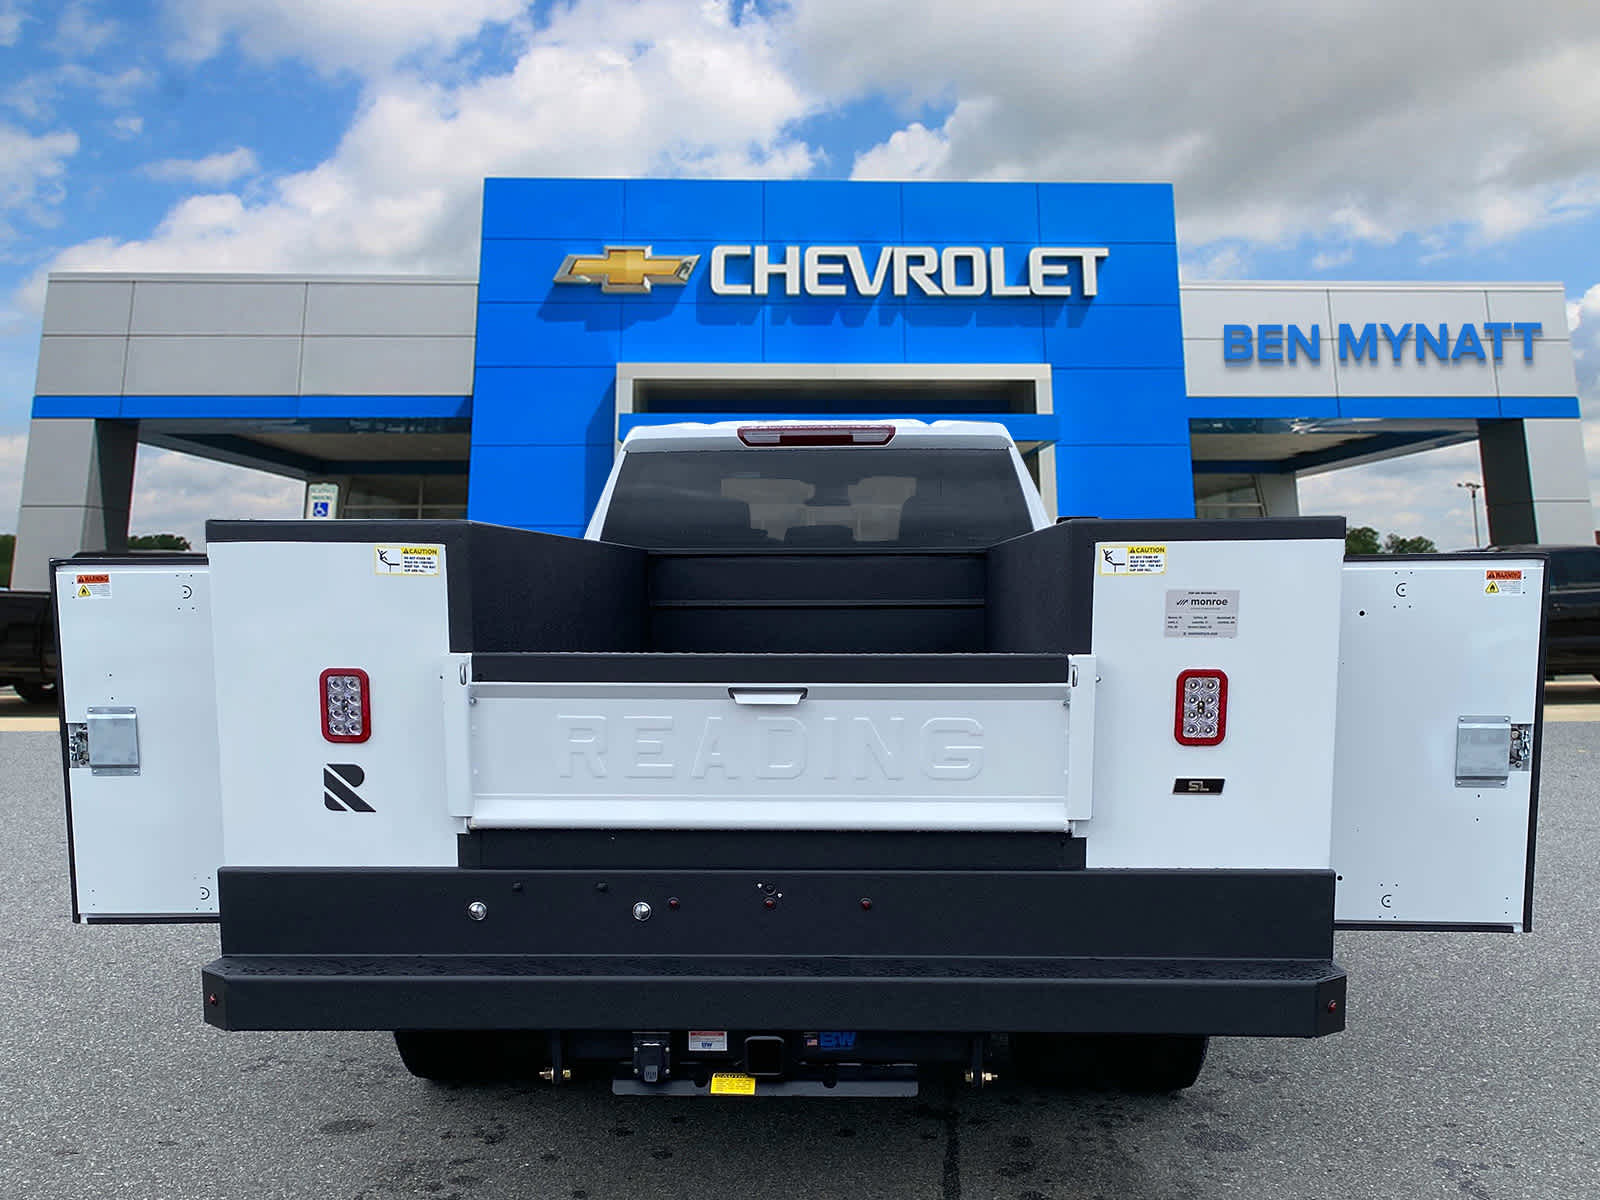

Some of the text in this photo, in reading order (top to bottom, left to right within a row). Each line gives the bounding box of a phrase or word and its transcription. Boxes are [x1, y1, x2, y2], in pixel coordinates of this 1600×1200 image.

[711, 245, 1110, 297] CHEVROLET
[1223, 321, 1543, 363] BEN MYNATT
[1135, 546, 1165, 554] CAUTION
[1190, 598, 1229, 606] monroe
[556, 713, 985, 781] READING
[1188, 780, 1210, 792] SL
